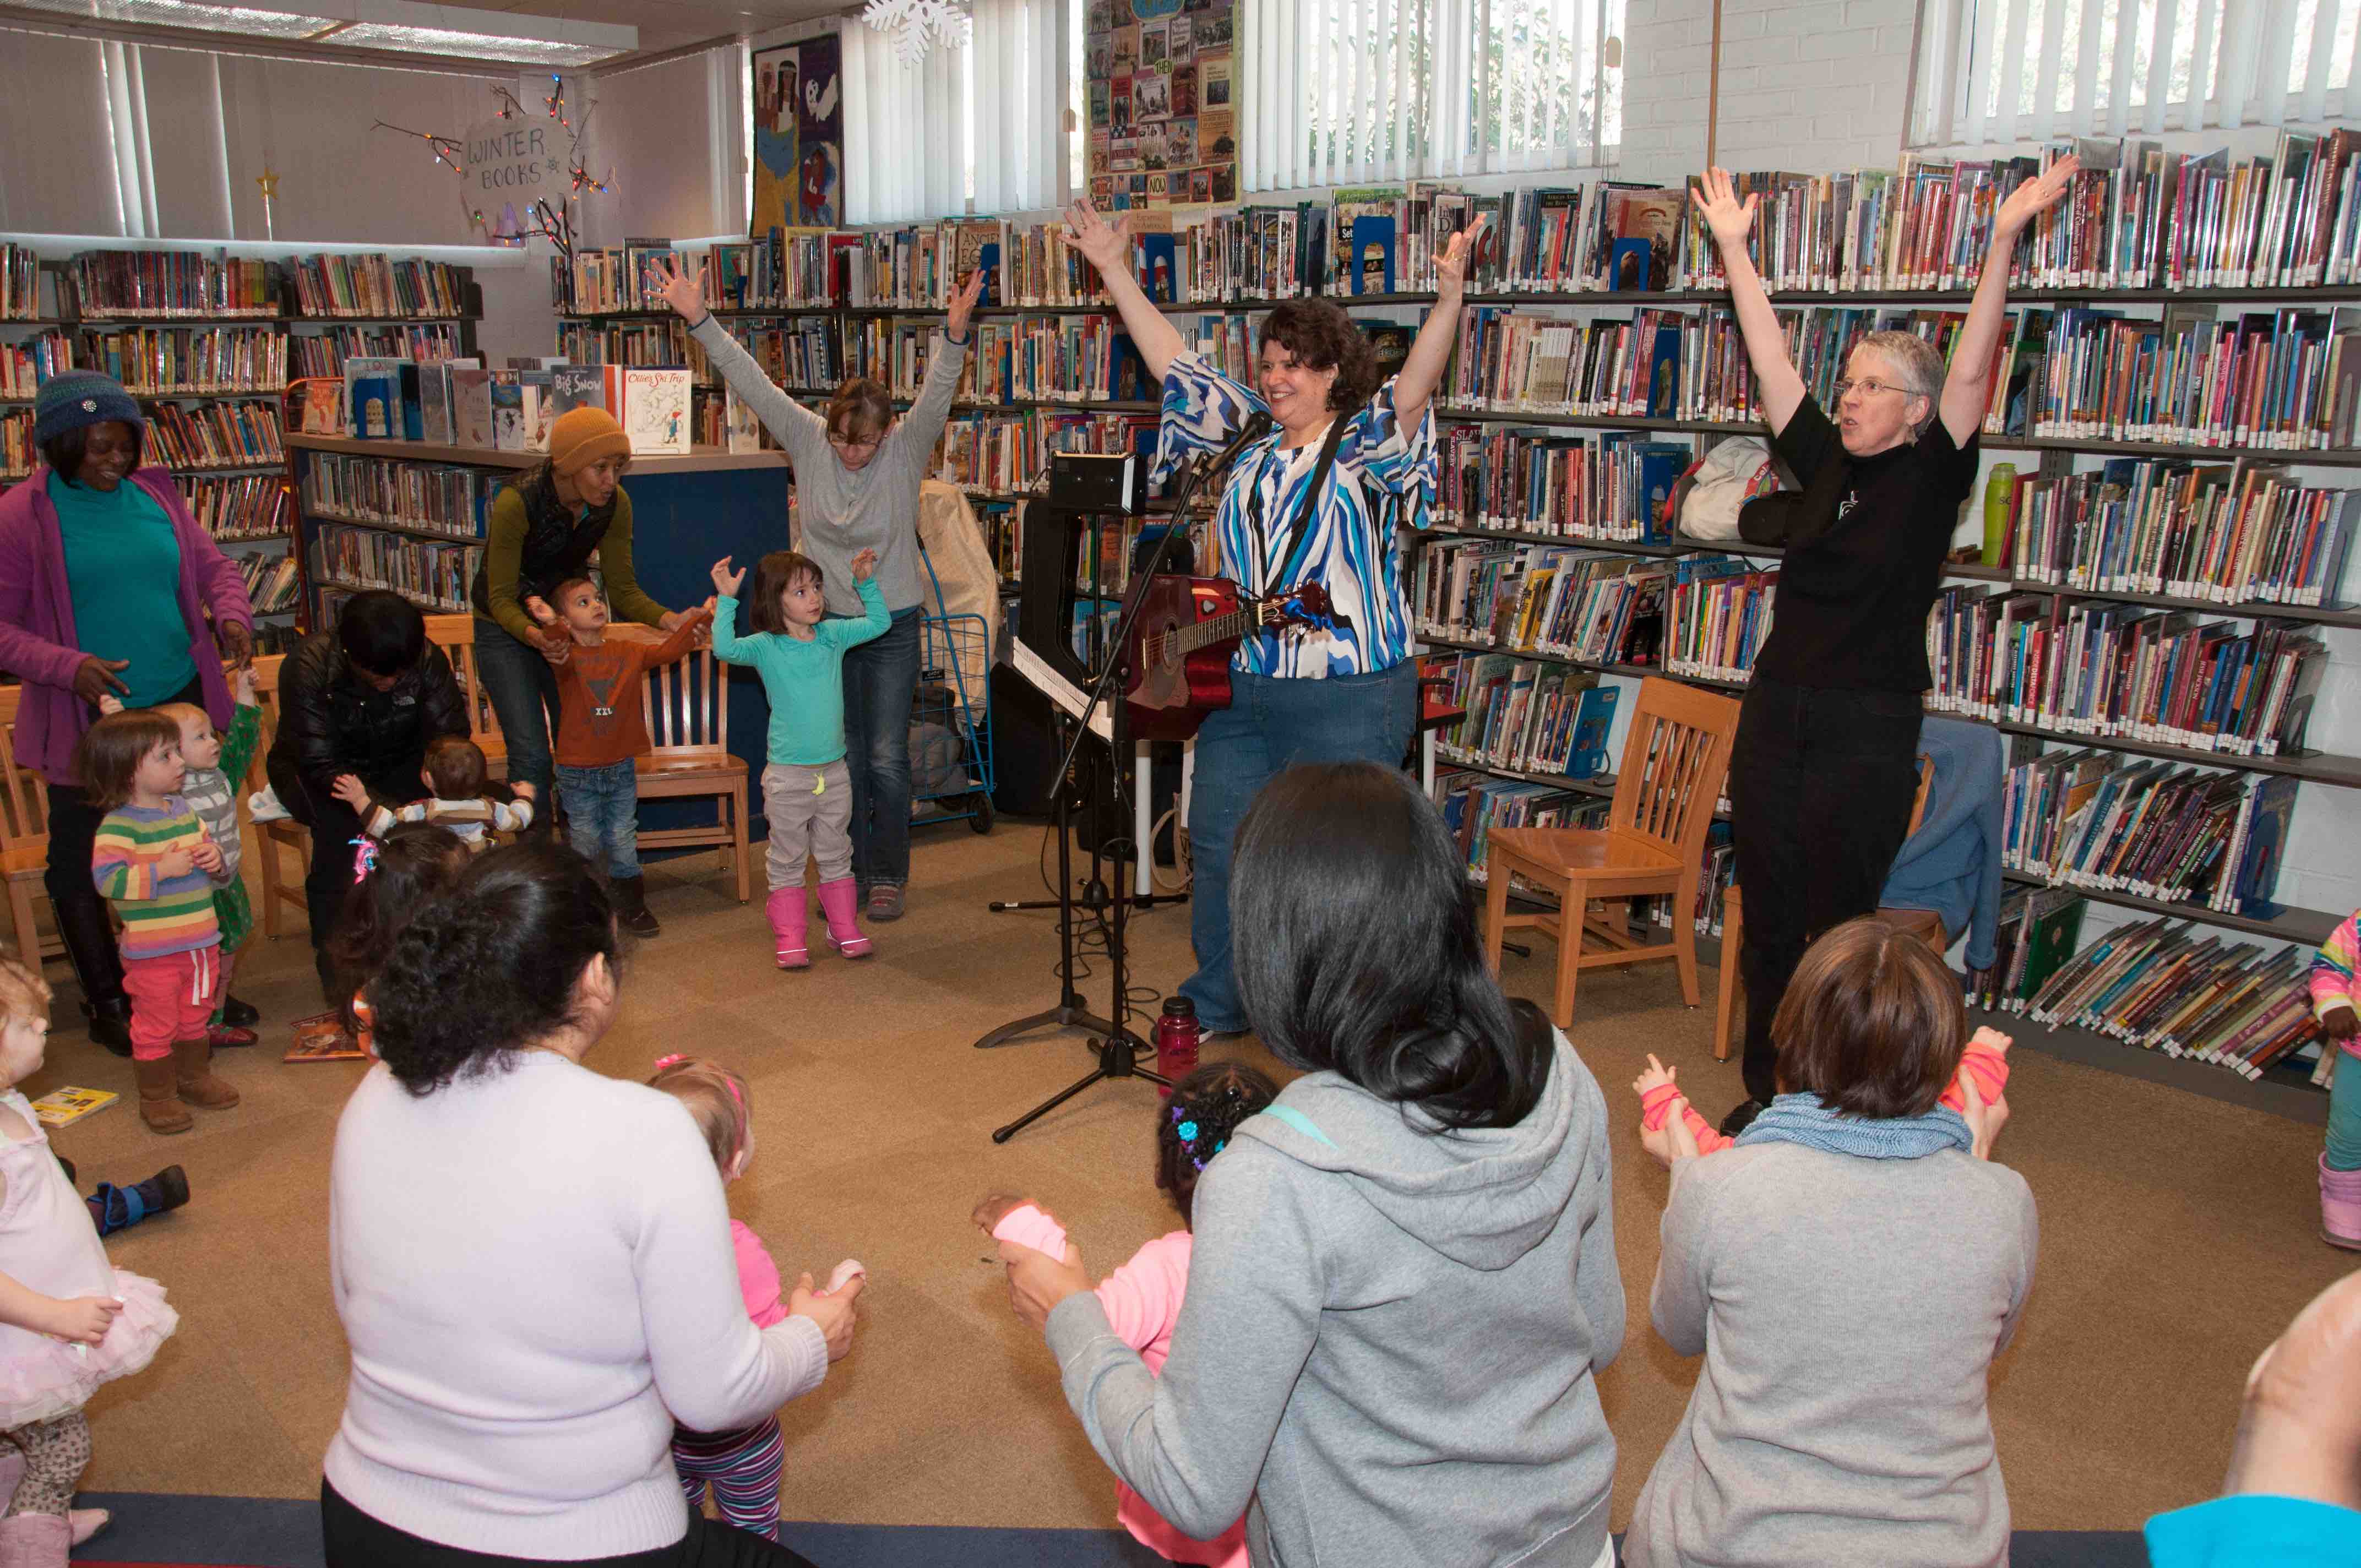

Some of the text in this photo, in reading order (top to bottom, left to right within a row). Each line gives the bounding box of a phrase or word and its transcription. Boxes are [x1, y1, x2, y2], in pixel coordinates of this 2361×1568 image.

[1155, 61, 1172, 74] THEN
[468, 128, 544, 164] WINTER
[481, 162, 541, 189] BOOKS
[1149, 177, 1166, 193] NOW
[554, 374, 602, 397] Big Snow
[628, 373, 686, 388] Ollie's Ski Trip
[2030, 668, 2039, 687] DELTA
[2192, 674, 2204, 700] JACKSON
[595, 707, 612, 716] XXL
[2185, 833, 2202, 856] PROMISED
